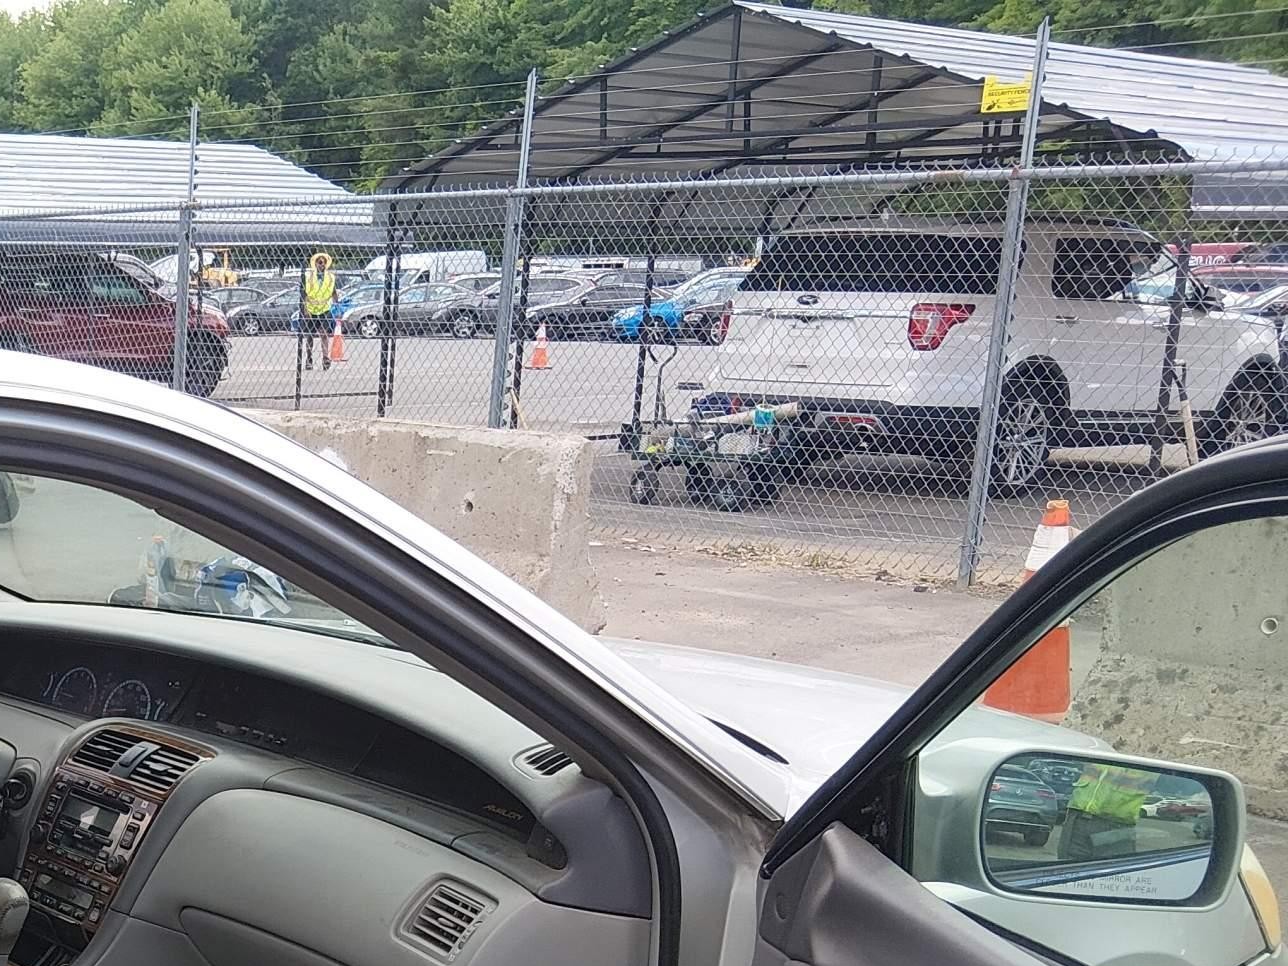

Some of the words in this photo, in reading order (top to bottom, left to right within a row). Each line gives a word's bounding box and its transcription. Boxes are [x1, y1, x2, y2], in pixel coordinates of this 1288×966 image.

[1073, 880, 1095, 890] THAN
[1099, 883, 1120, 892] THEY
[1125, 884, 1158, 894] APPEAR
